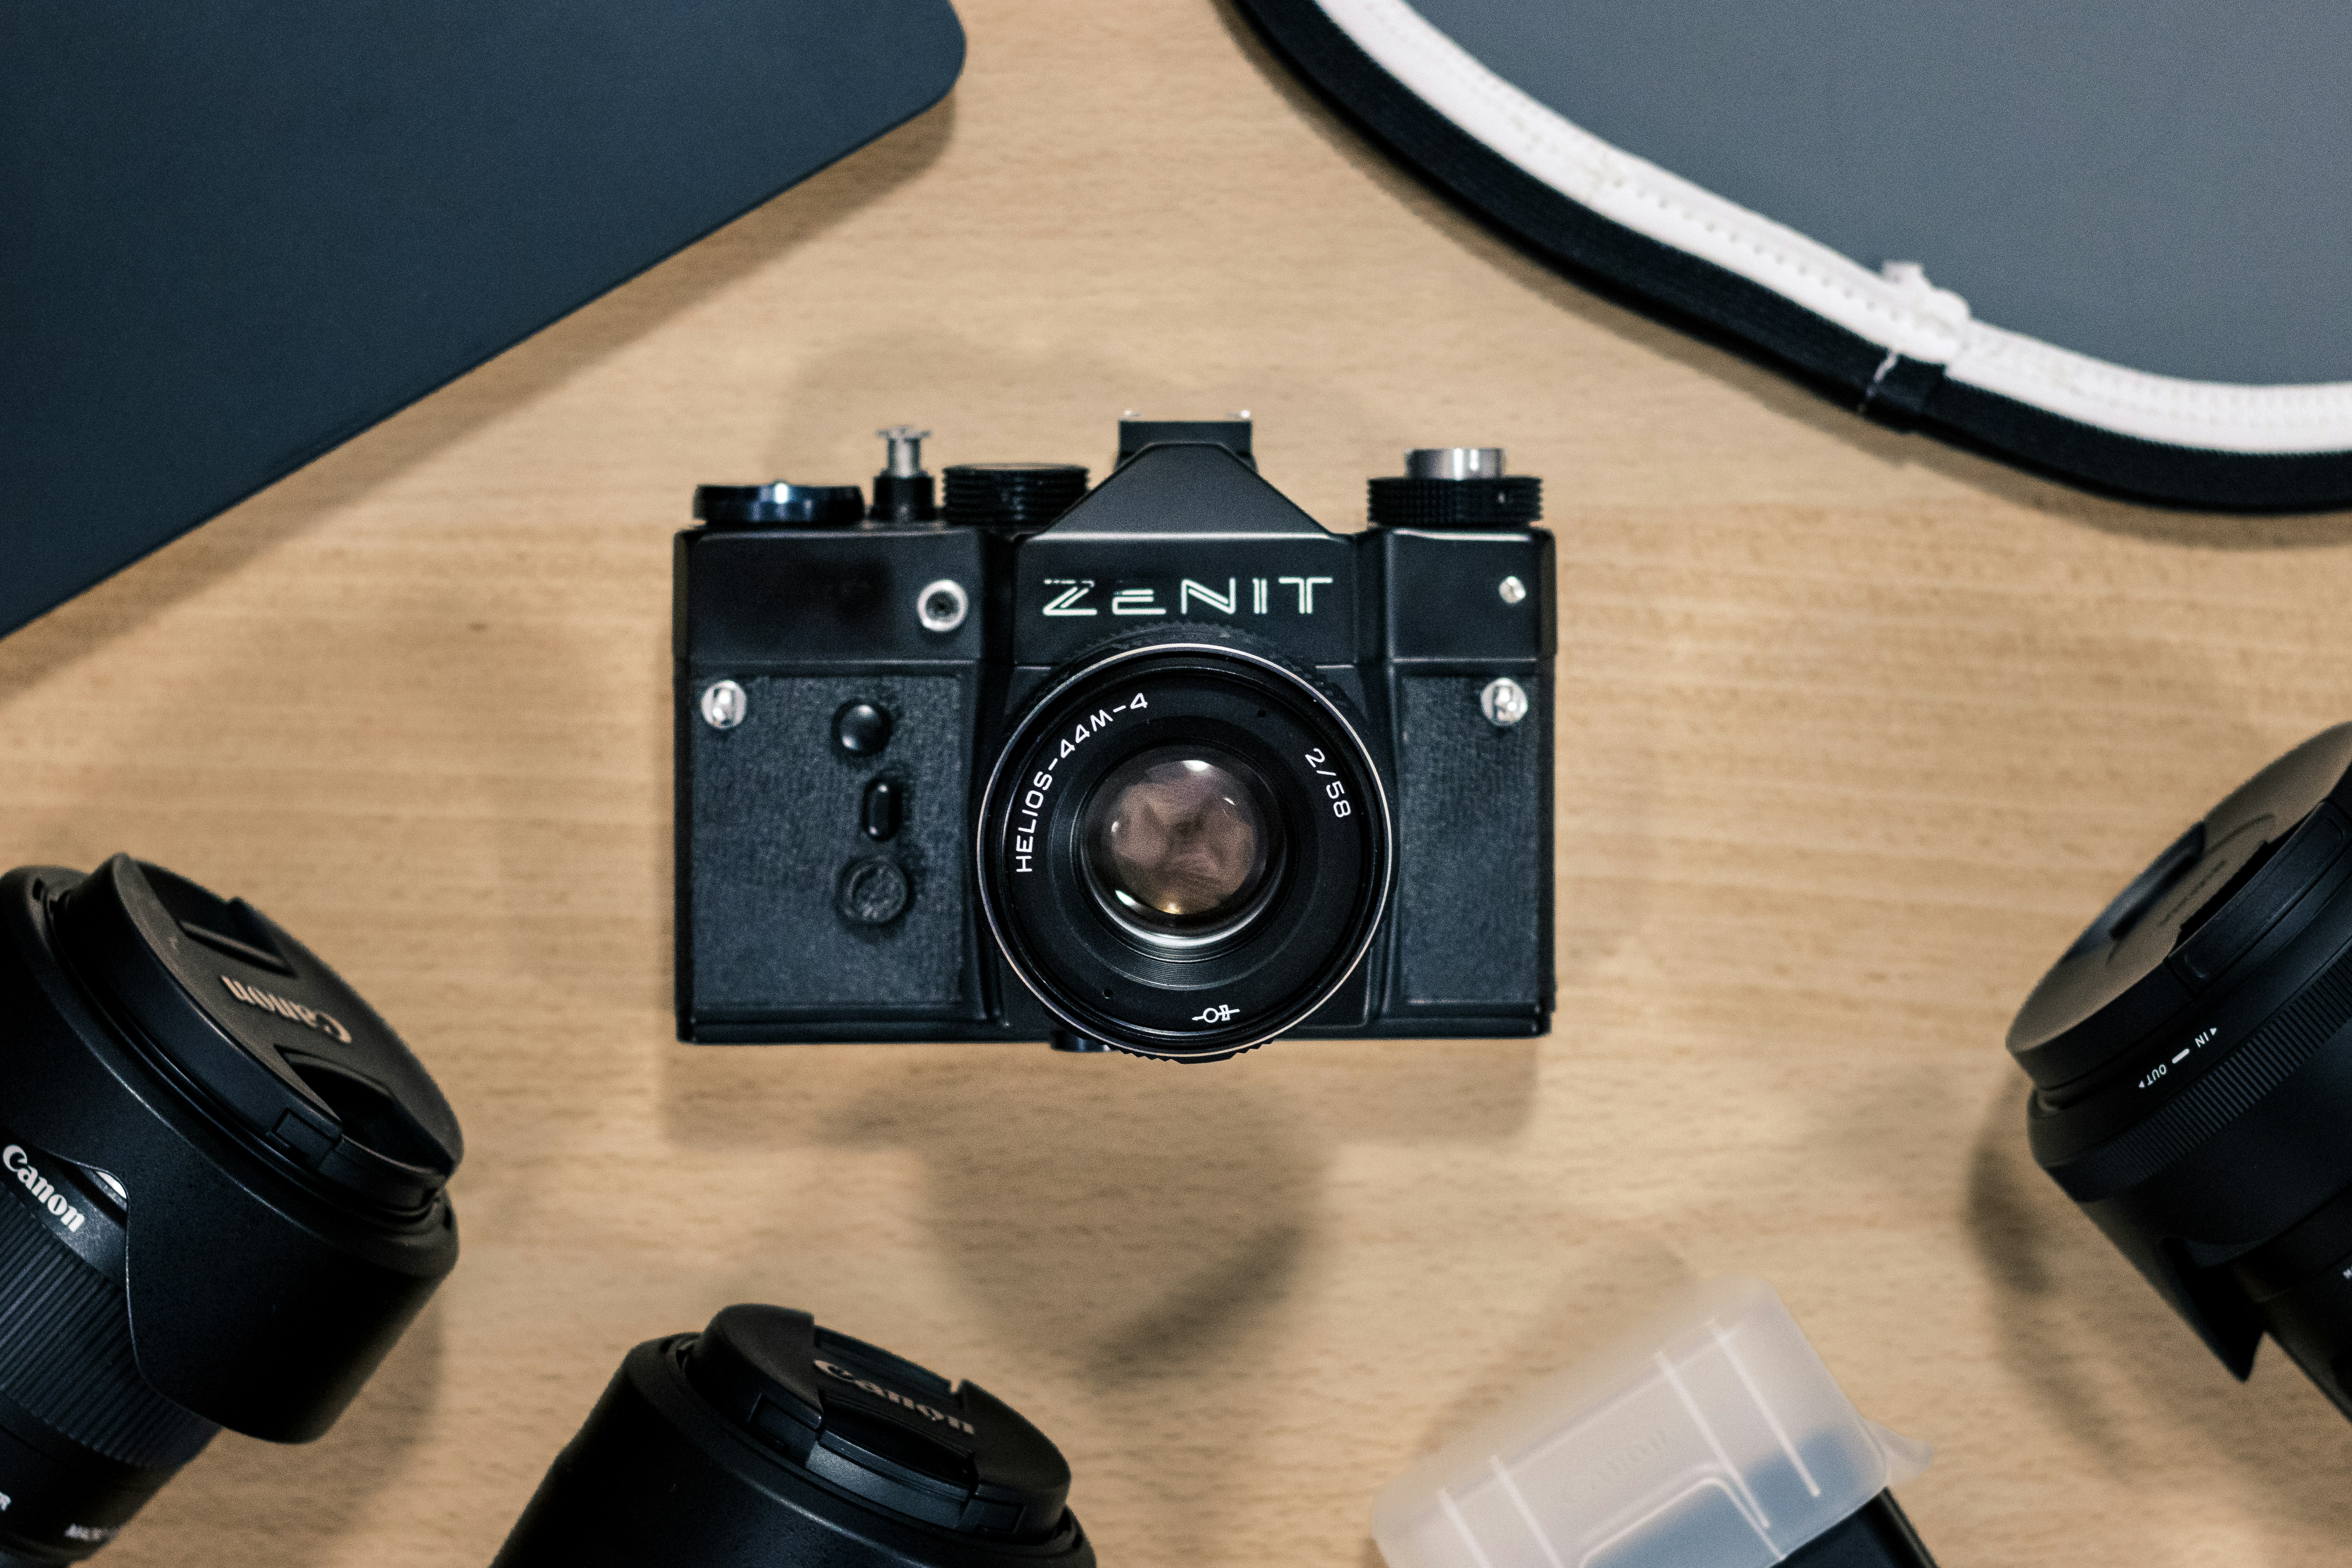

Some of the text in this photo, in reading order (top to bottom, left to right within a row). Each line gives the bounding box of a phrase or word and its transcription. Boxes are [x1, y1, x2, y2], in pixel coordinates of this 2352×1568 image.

[1041, 576, 1334, 616] ZENIT
[1016, 692, 1149, 873] HELIOS-44M-4
[1305, 748, 1351, 818] 2/58
[220, 975, 352, 1044] Canon
[2147, 1031, 2209, 1086] IN OUT
[2, 1145, 86, 1234] Canon
[813, 1359, 976, 1436] Canon
